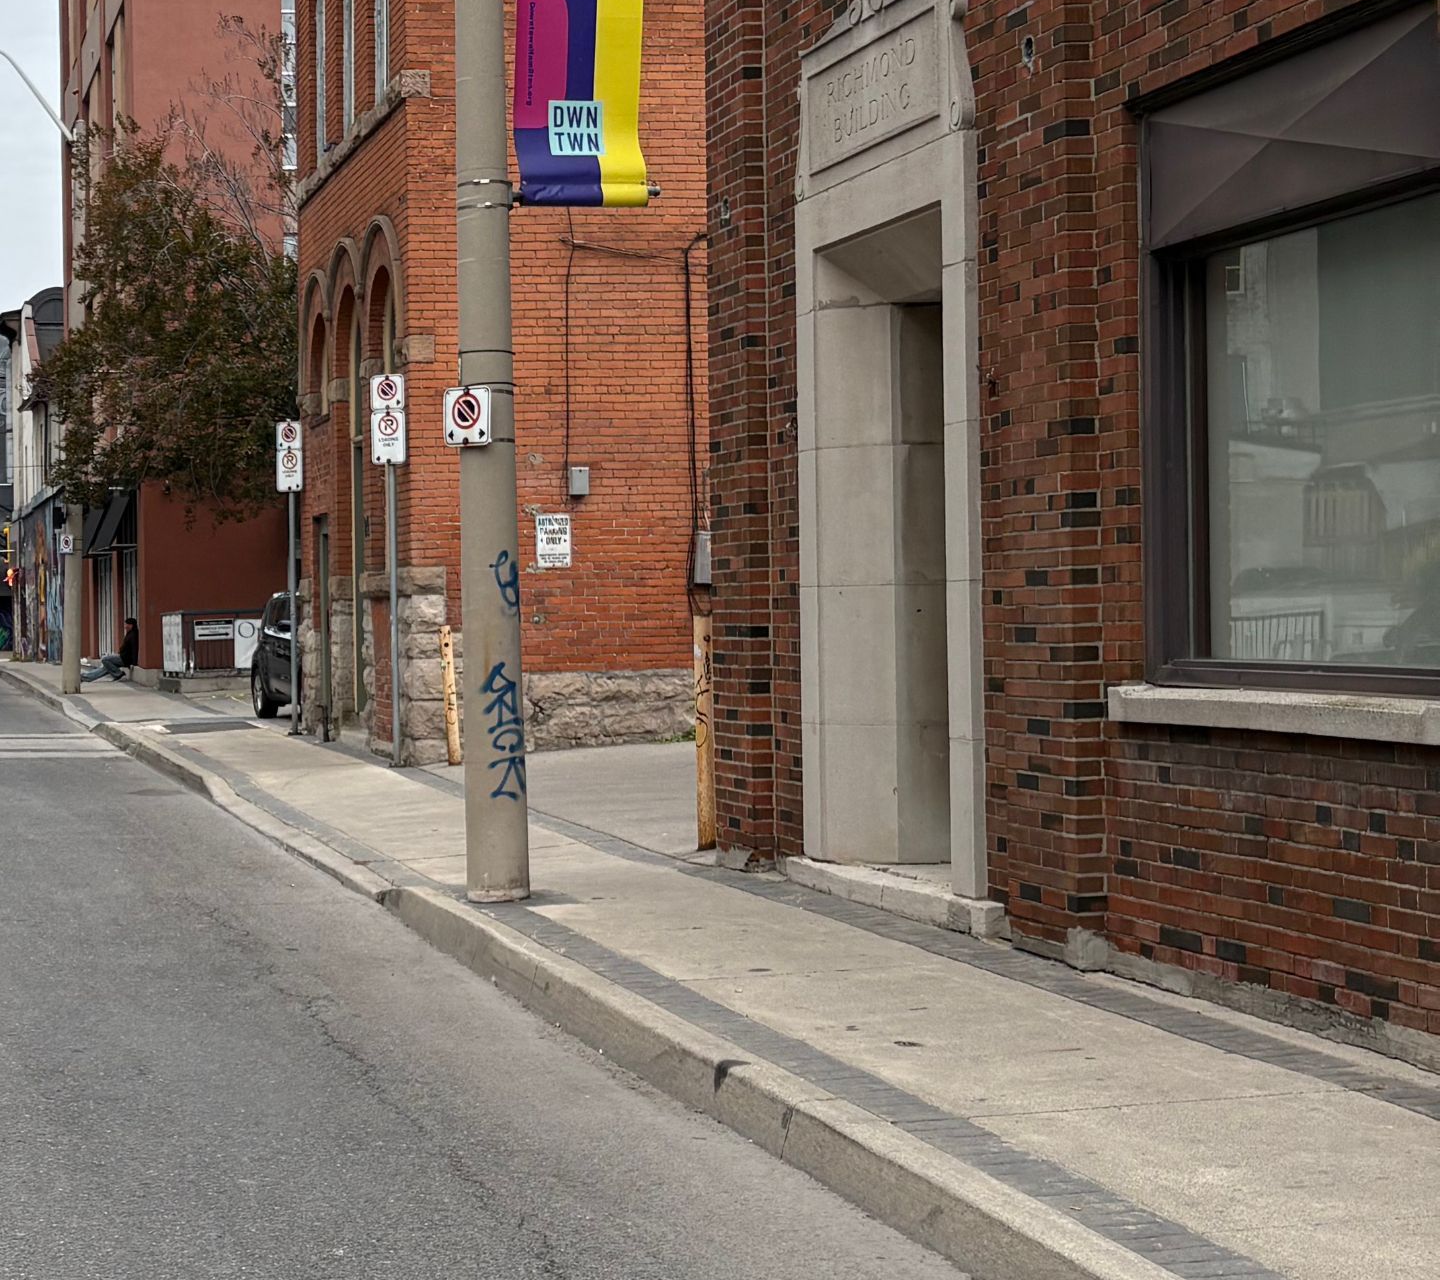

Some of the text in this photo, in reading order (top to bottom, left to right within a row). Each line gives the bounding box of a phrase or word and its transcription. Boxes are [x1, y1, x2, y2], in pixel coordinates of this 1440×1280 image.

[826, 38, 916, 107] RICHMOND
[553, 105, 598, 129] DWN
[834, 82, 911, 143] BUILDING
[554, 132, 600, 152] TWN
[545, 537, 561, 545] ONLY
